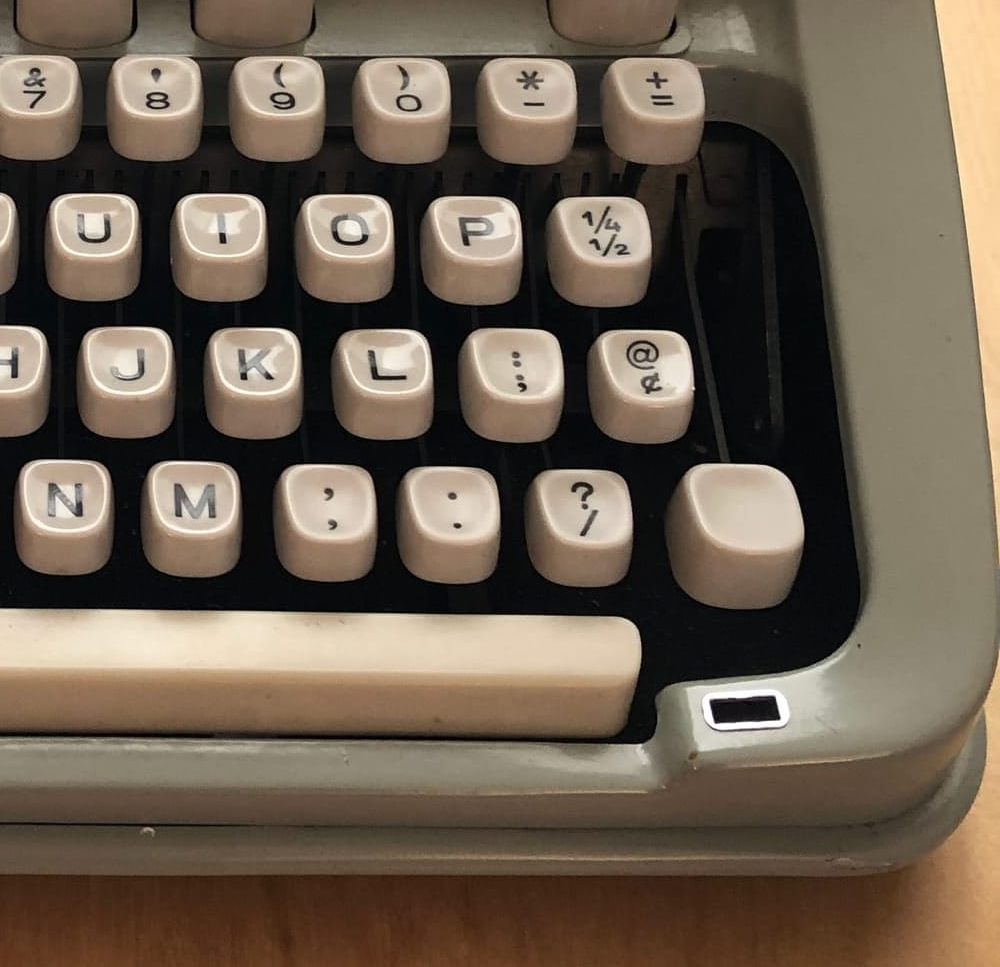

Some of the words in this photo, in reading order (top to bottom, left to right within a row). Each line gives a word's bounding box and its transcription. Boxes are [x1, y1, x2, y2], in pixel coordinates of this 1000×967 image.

[23, 66, 47, 88] &
[273, 61, 286, 89] (
[396, 64, 410, 91] )
[22, 89, 47, 110] 7
[145, 91, 171, 111] 8
[269, 91, 296, 111] 9
[77, 213, 112, 245] U
[458, 216, 494, 247] P
[110, 349, 146, 382] J
[238, 349, 276, 382] K
[368, 349, 407, 381] L
[625, 339, 660, 371] @
[47, 481, 84, 518] N
[173, 482, 217, 520] M
[570, 481, 595, 511] ?
